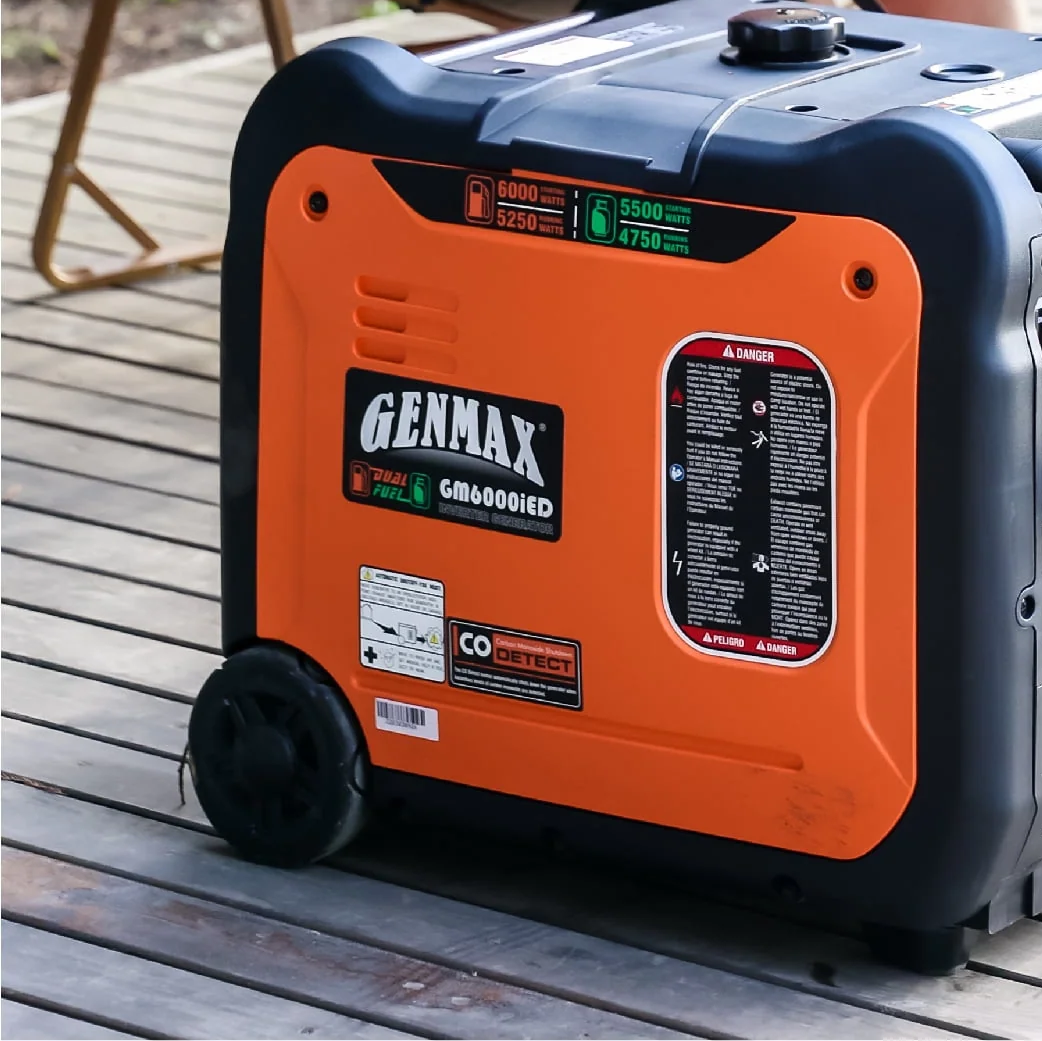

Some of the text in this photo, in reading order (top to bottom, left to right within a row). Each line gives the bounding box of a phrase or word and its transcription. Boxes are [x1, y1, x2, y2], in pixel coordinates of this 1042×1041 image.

[498, 180, 538, 202] 6000
[540, 196, 565, 206] WATTS
[620, 198, 663, 220] 5500
[497, 209, 537, 231] 5250
[665, 213, 691, 225] WATTS
[539, 224, 564, 235] WATTS
[619, 228, 661, 250] 4750
[663, 243, 689, 254] WATTS
[736, 347, 775, 363] DANGER
[360, 391, 545, 488] GENMAX
[373, 468, 408, 487] DUAL
[373, 483, 405, 501] FUEL
[439, 478, 554, 518] GM6000iED
[459, 631, 492, 657] CO
[713, 635, 745, 648] PELIGRO
[766, 643, 797, 656] DANGER
[496, 647, 573, 673] DETECT
